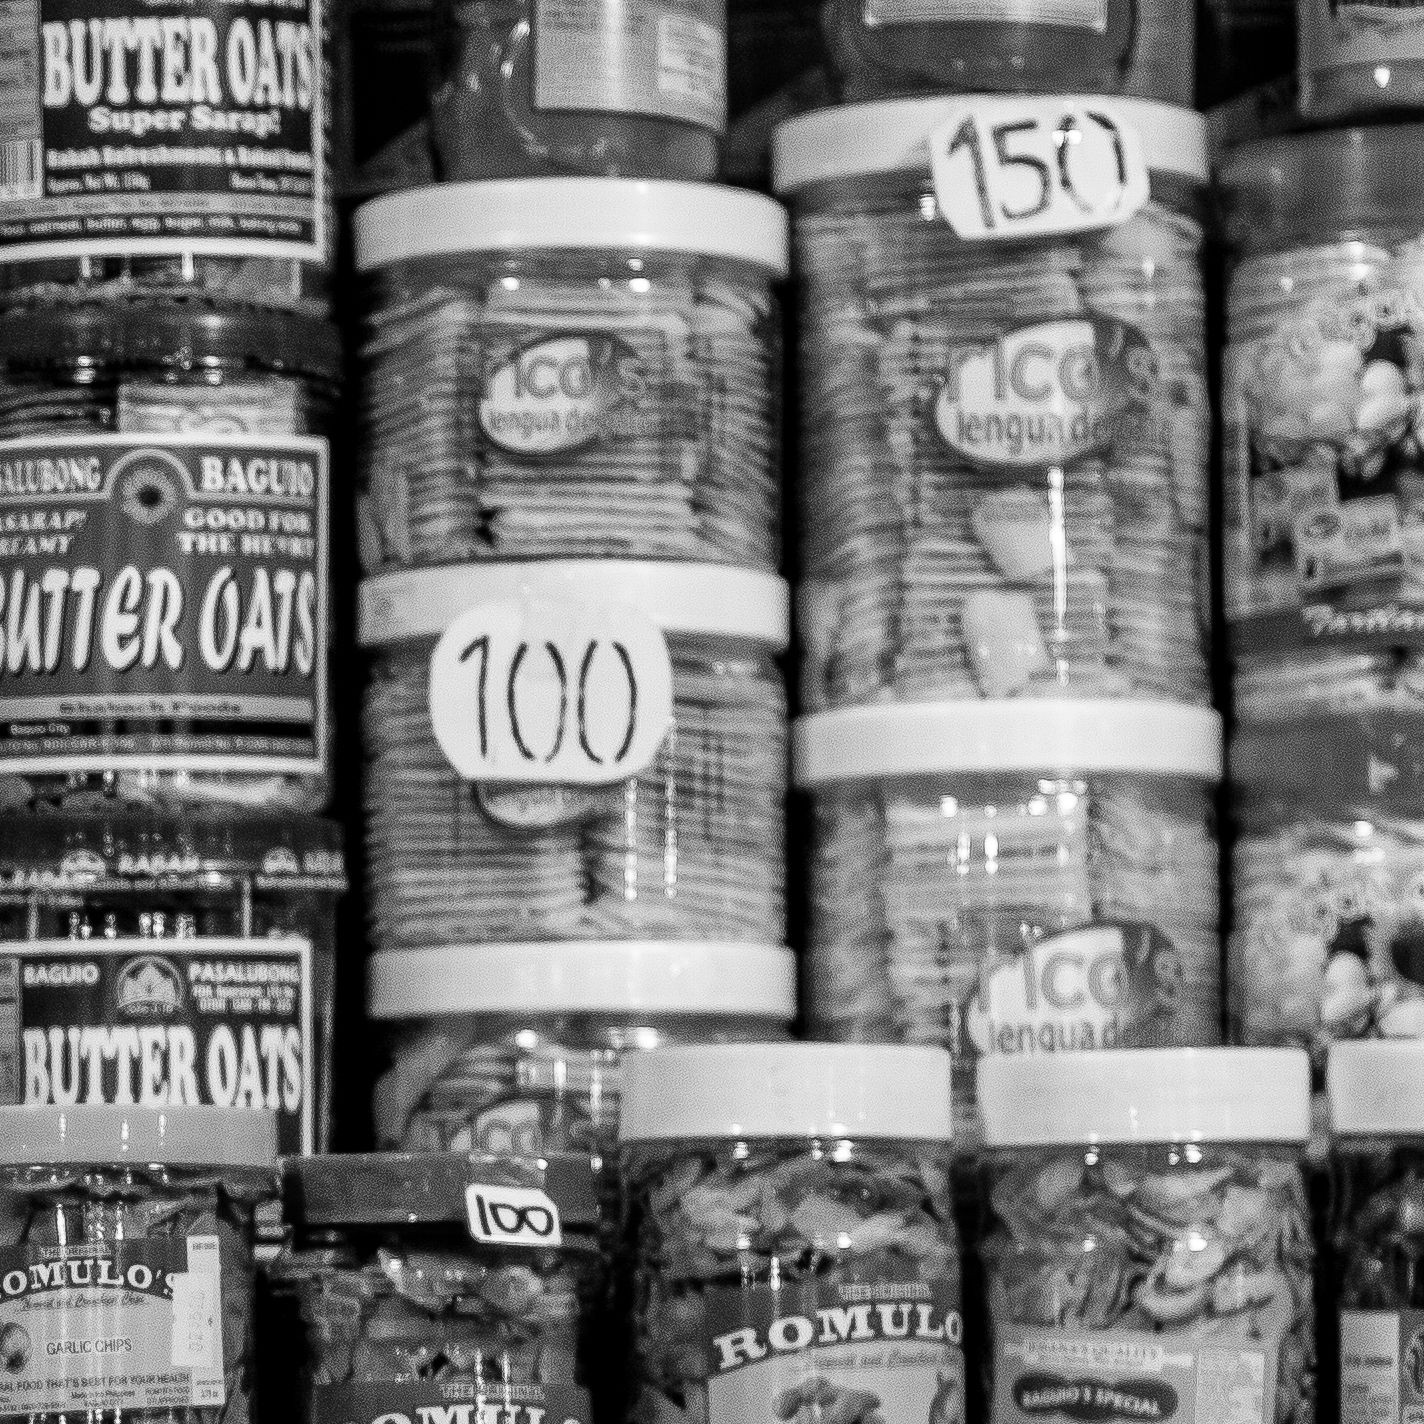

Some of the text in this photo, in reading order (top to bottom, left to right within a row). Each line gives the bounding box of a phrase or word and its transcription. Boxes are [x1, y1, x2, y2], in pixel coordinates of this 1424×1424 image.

[948, 111, 1130, 231] 150
[200, 566, 315, 676] OATS
[459, 634, 638, 765] 100
[23, 1024, 302, 1113] BUTTER OATS
[475, 1193, 554, 1237] 100
[47, 1338, 132, 1356] GARLIC CHIPS
